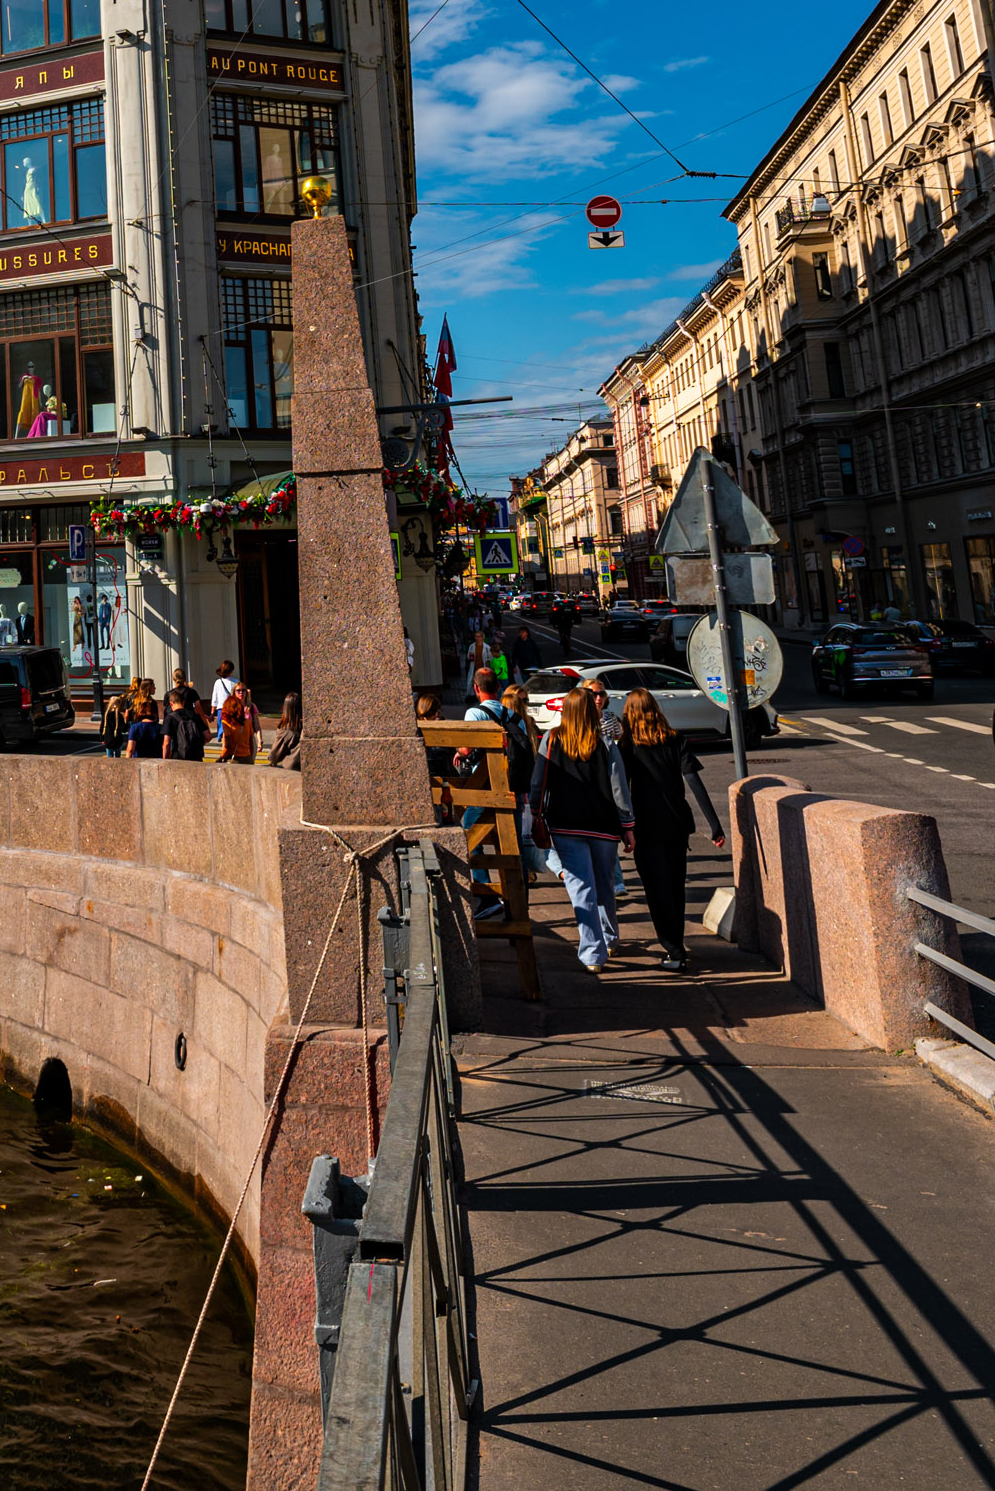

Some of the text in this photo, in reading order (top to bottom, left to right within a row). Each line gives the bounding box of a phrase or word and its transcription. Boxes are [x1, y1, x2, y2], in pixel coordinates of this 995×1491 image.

[211, 56, 339, 83] AU PONT ROUGE
[218, 239, 292, 257] У КРАСНАГ
